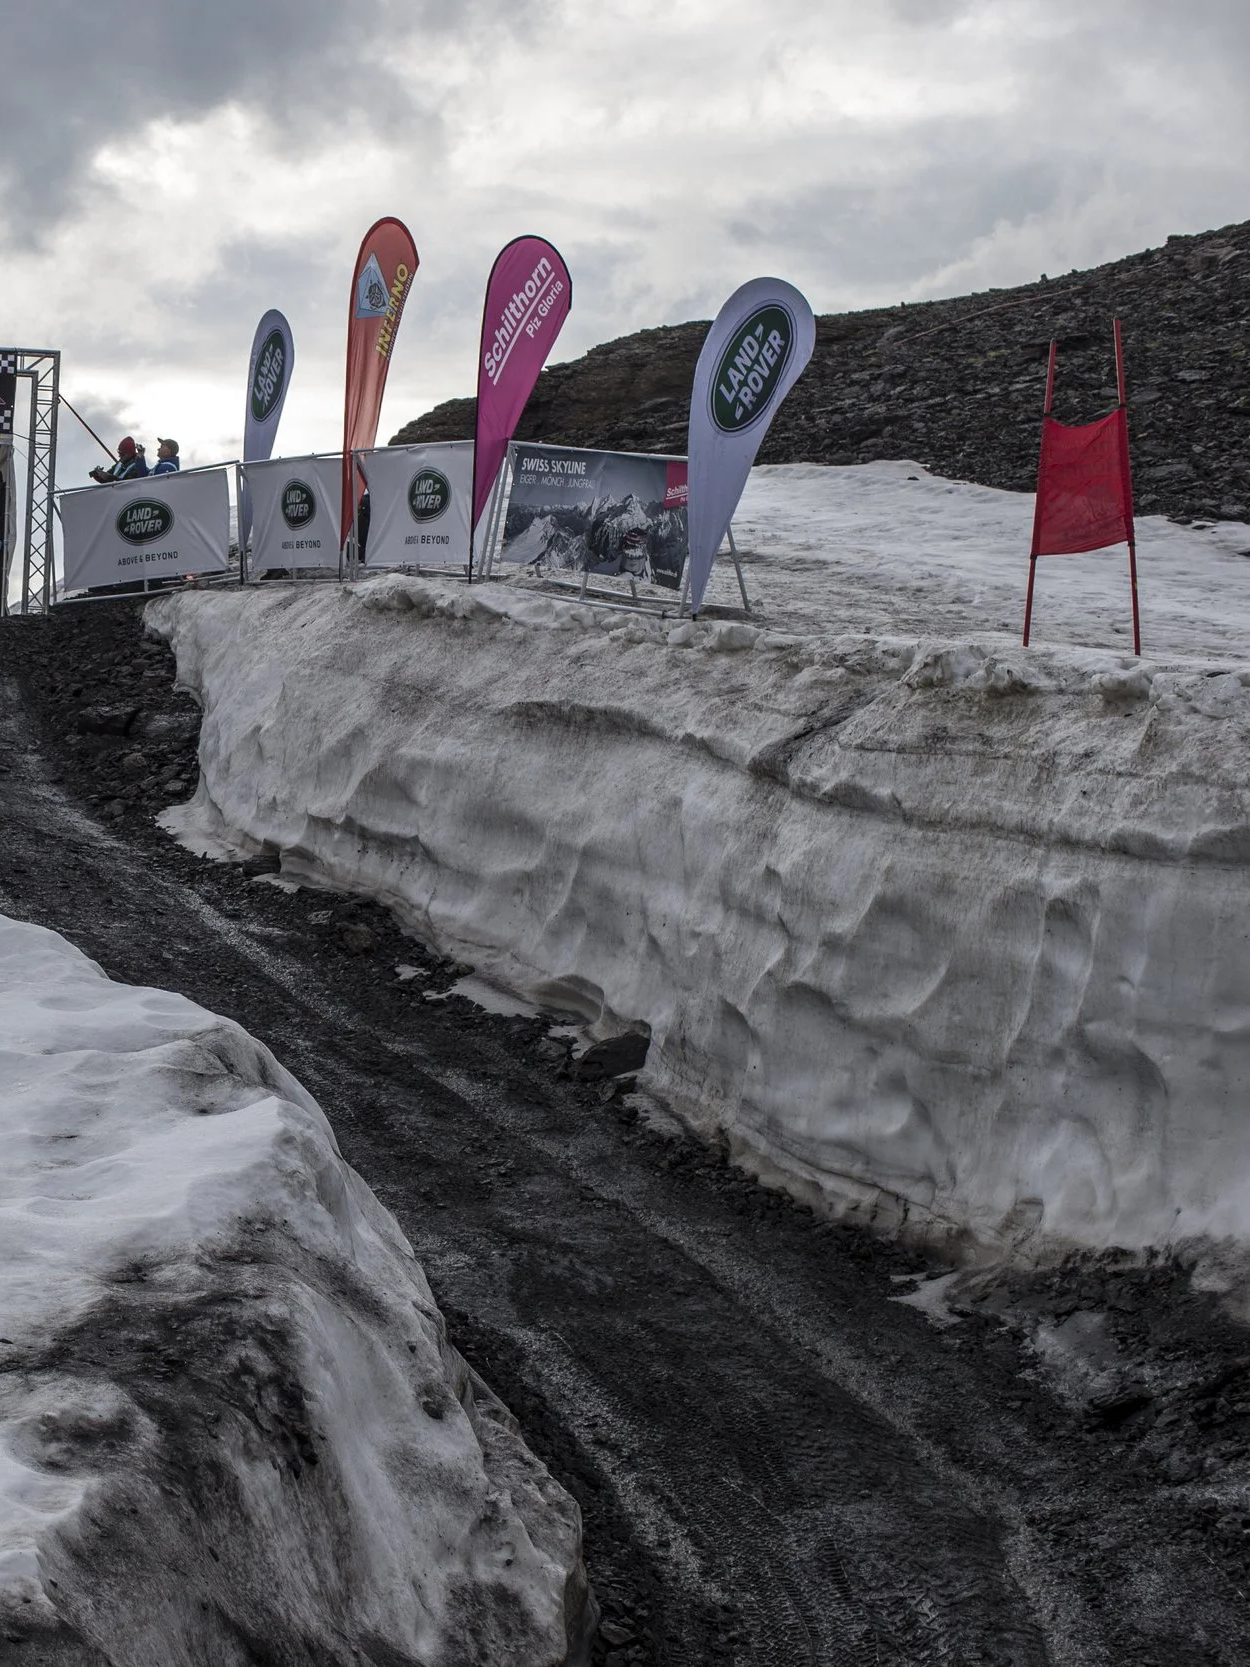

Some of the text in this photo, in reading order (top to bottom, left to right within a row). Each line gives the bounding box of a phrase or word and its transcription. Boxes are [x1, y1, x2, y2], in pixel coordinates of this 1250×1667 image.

[375, 263, 409, 357] INFERNO
[525, 280, 564, 338] Piz Gloria
[484, 257, 552, 378] Schilthorn
[253, 351, 271, 401] LAND
[719, 335, 760, 404] LAND
[738, 329, 786, 411] ROVER
[521, 457, 587, 475] SWISS SKYLINE
[519, 474, 537, 485] EIGER
[286, 490, 301, 503] LND
[416, 494, 442, 509] VER
[126, 507, 152, 522] LAND
[288, 503, 309, 517] VER
[130, 519, 163, 535] ROVER
[295, 540, 321, 549] BEYOND
[420, 535, 450, 544] BEYOND
[117, 556, 138, 567] ABOVE
[145, 551, 179, 562] BEYOND
